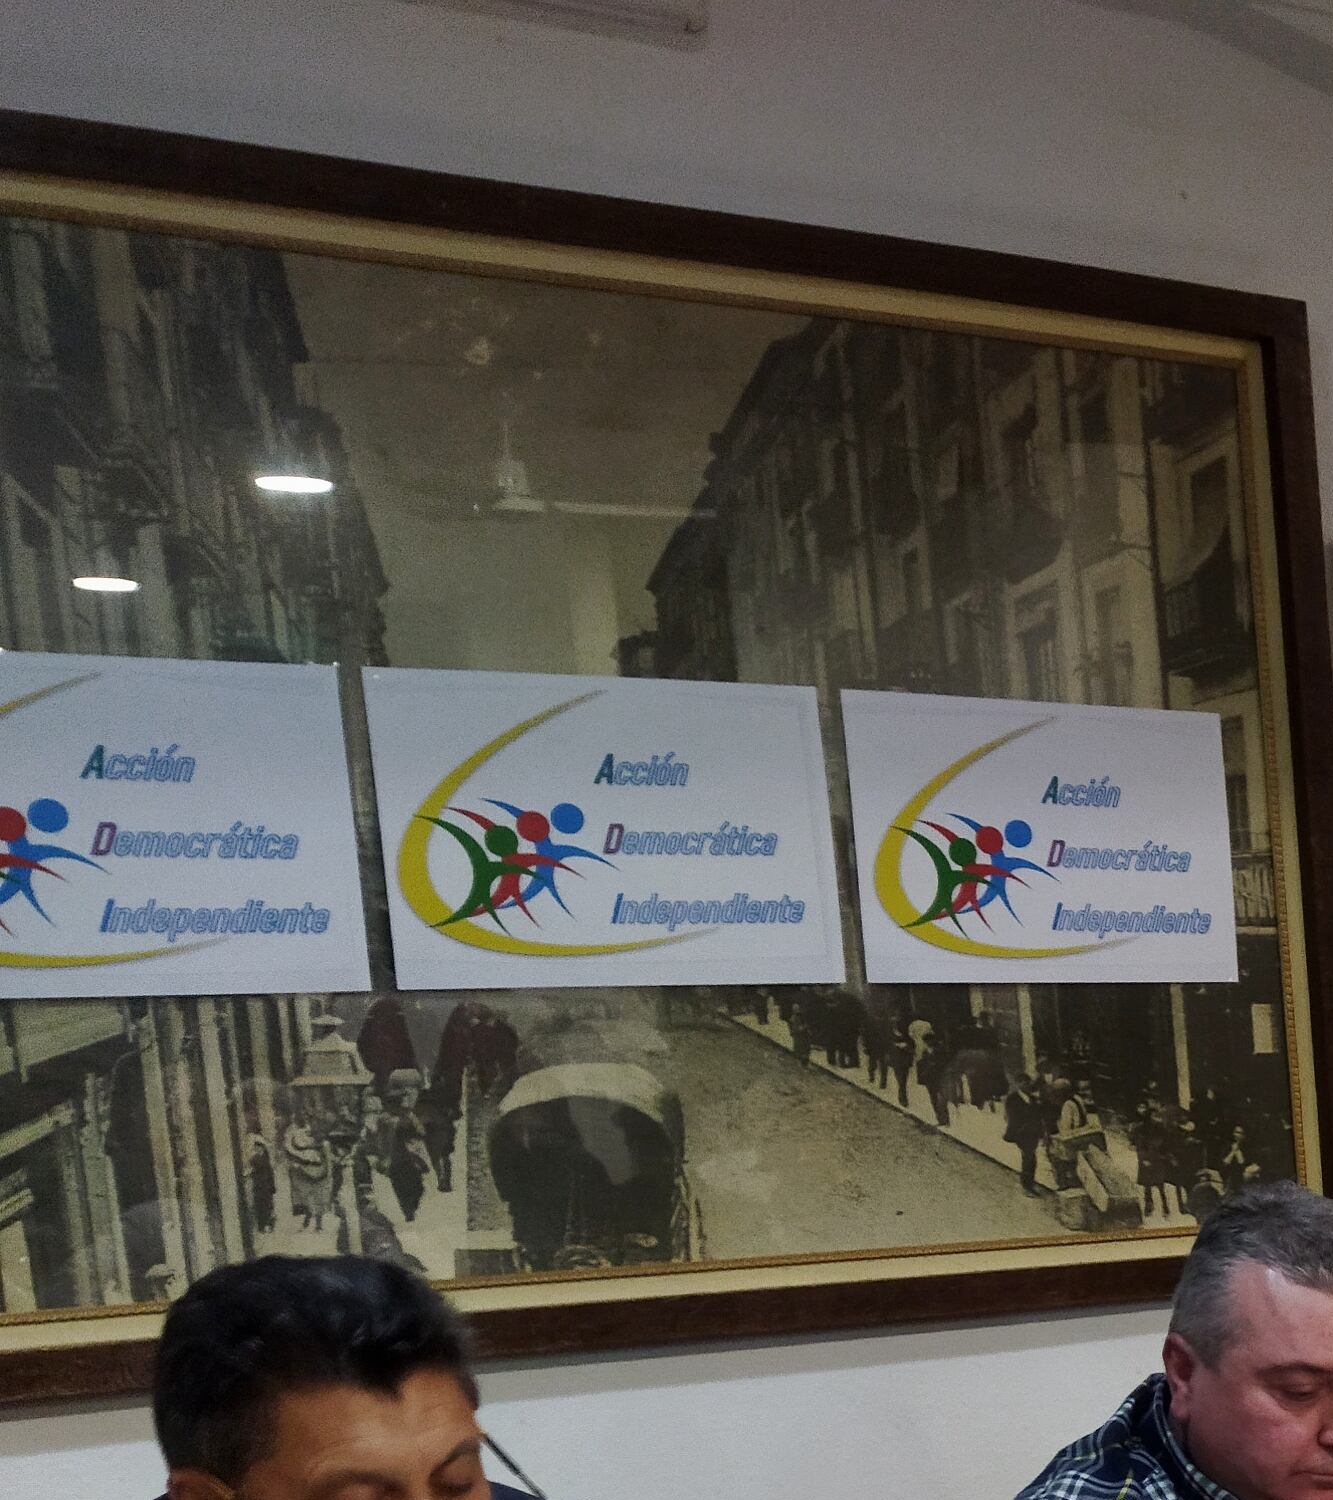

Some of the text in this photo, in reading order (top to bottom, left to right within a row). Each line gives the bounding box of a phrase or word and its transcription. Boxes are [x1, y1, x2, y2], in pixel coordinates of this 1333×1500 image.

[79, 744, 196, 783] Acción
[593, 751, 690, 786] Acción
[1041, 775, 1122, 808] Acción
[90, 820, 299, 860] Democrática
[603, 821, 778, 857] Democrática
[1046, 840, 1192, 873] Democrática
[99, 898, 331, 943] Independiente
[611, 892, 807, 931] Independiente
[1051, 902, 1212, 938] Independiente
